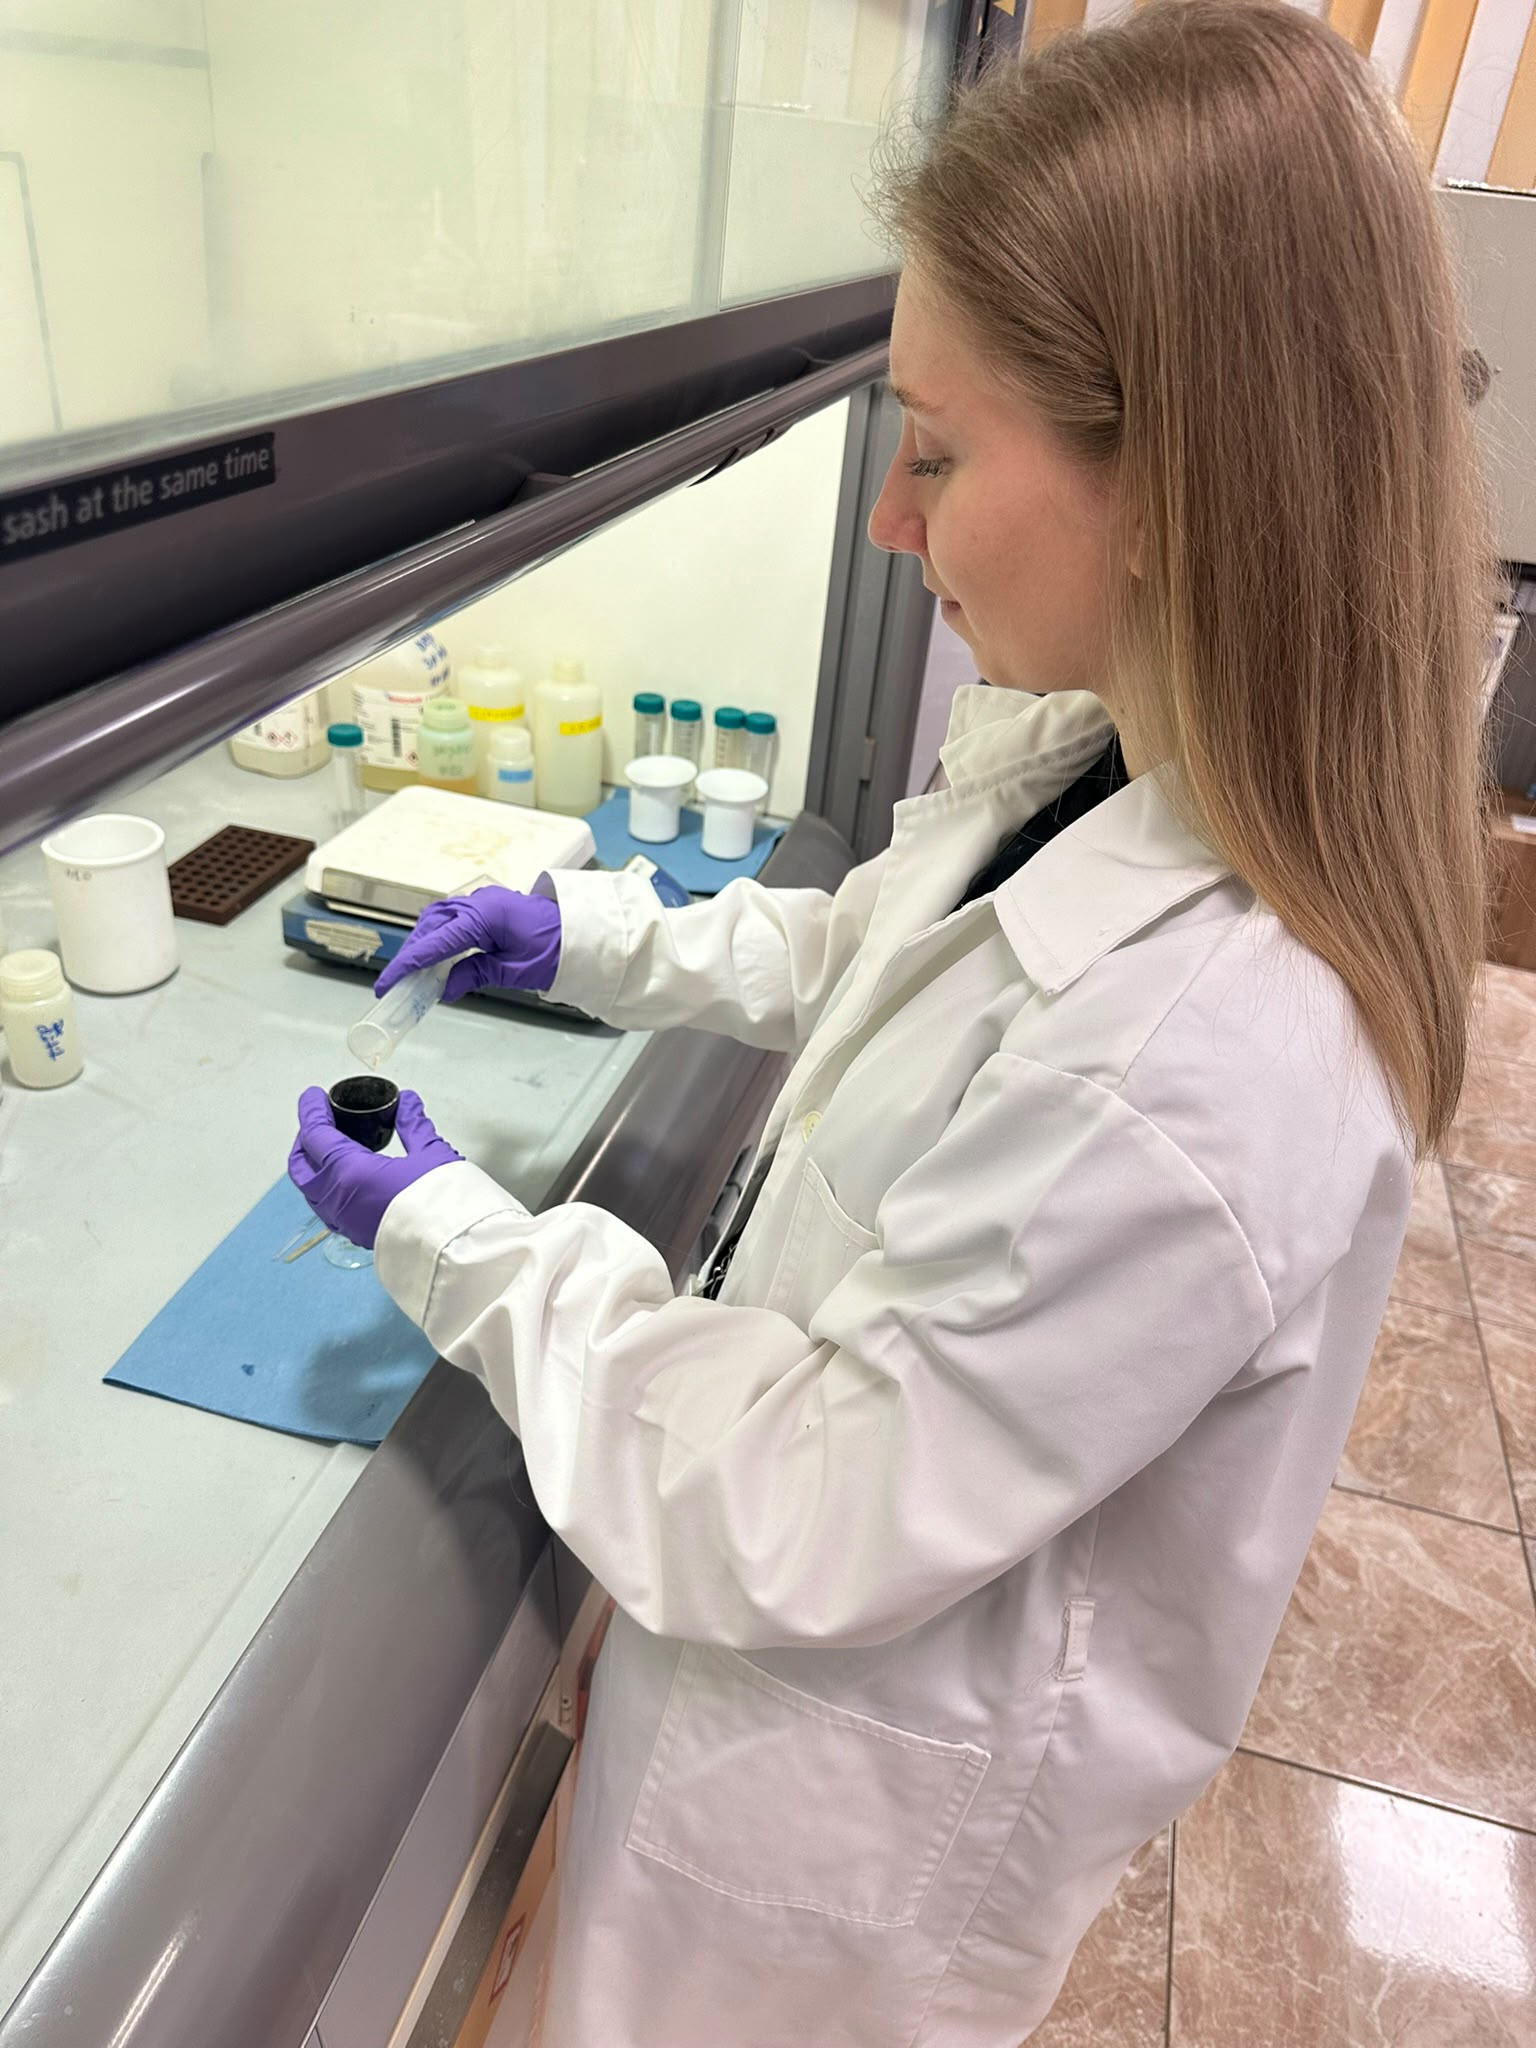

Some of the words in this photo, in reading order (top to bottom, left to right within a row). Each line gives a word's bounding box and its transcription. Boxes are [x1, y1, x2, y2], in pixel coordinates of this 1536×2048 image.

[3, 491, 68, 545] sash
[75, 486, 105, 524] at
[111, 475, 153, 513] the
[160, 461, 219, 500] same
[224, 447, 270, 481] time
